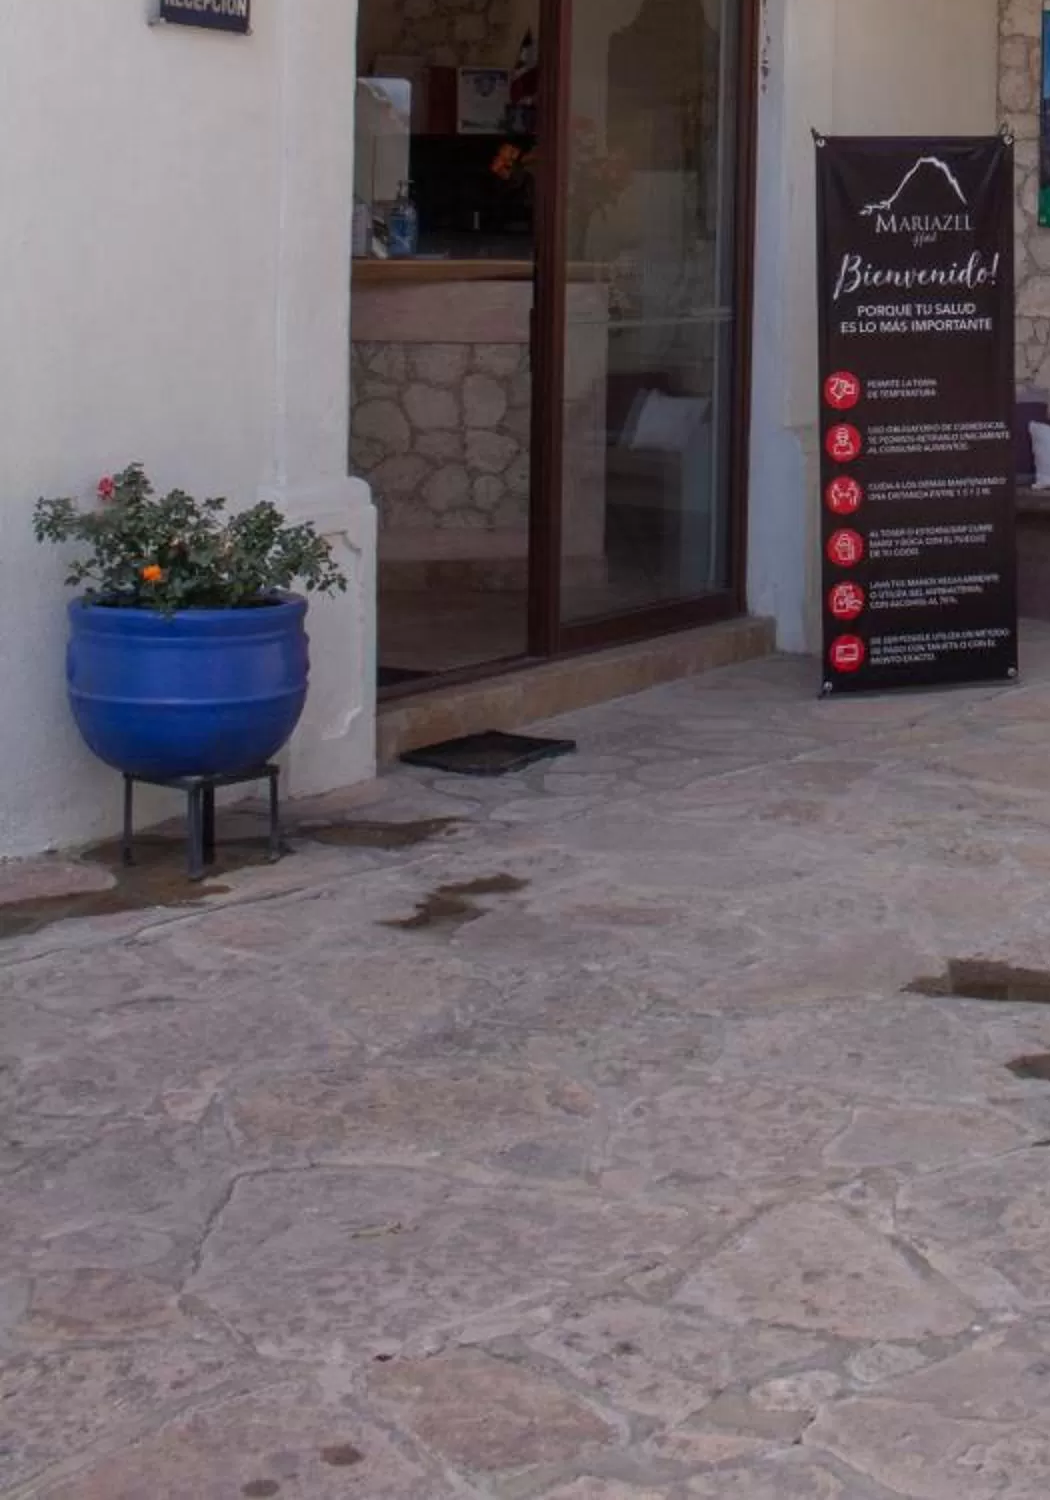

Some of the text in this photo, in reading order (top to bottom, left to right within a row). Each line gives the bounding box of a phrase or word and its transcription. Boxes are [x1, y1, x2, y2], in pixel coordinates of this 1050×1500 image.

[833, 250, 1000, 300] Bienvenido!
[857, 302, 977, 317] PORQUE TU SALUD
[840, 321, 857, 333] ES
[859, 321, 877, 333] LO
[911, 317, 993, 331] IMPORTANTE
